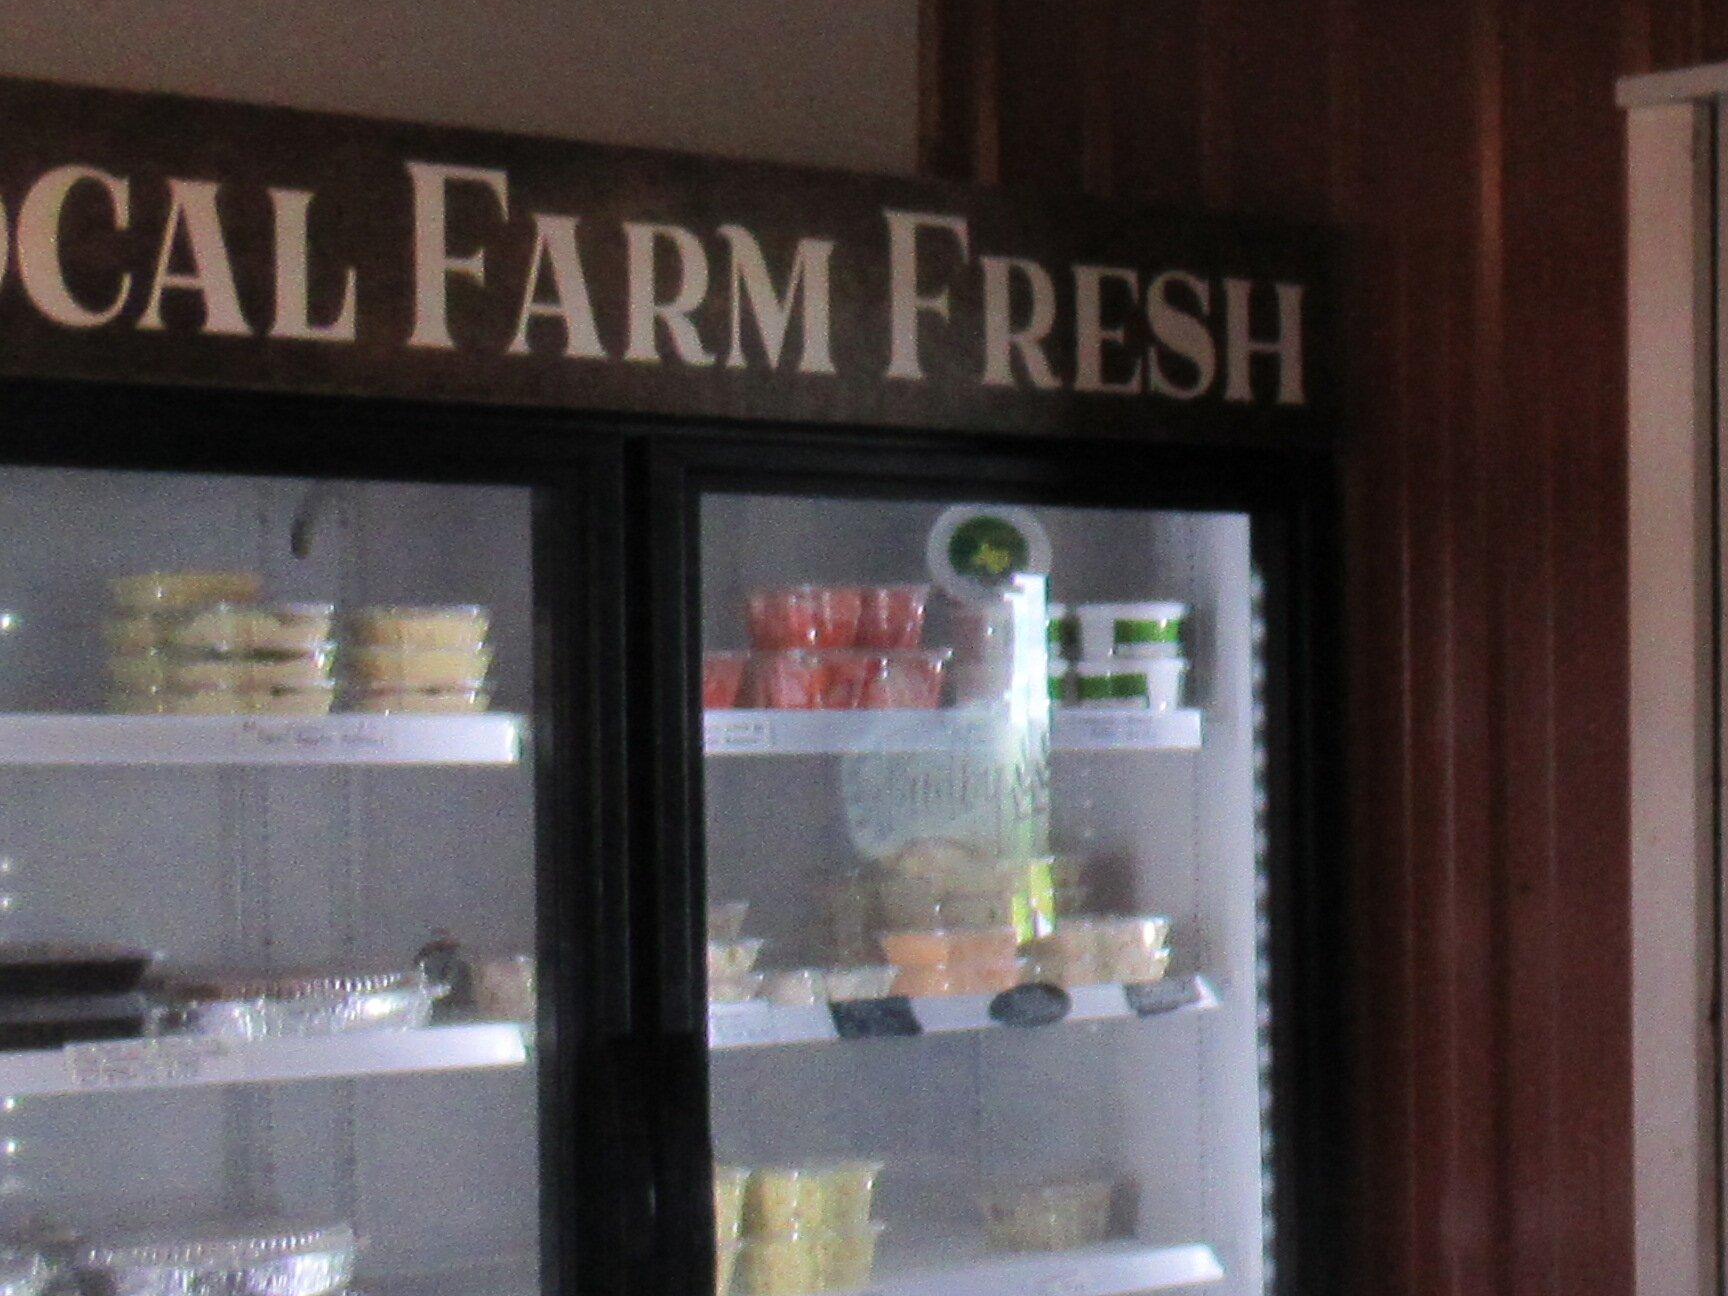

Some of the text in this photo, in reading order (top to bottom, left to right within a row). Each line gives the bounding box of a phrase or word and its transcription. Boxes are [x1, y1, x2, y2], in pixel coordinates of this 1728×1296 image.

[0, 160, 1307, 405] CAL FARM FRESH
